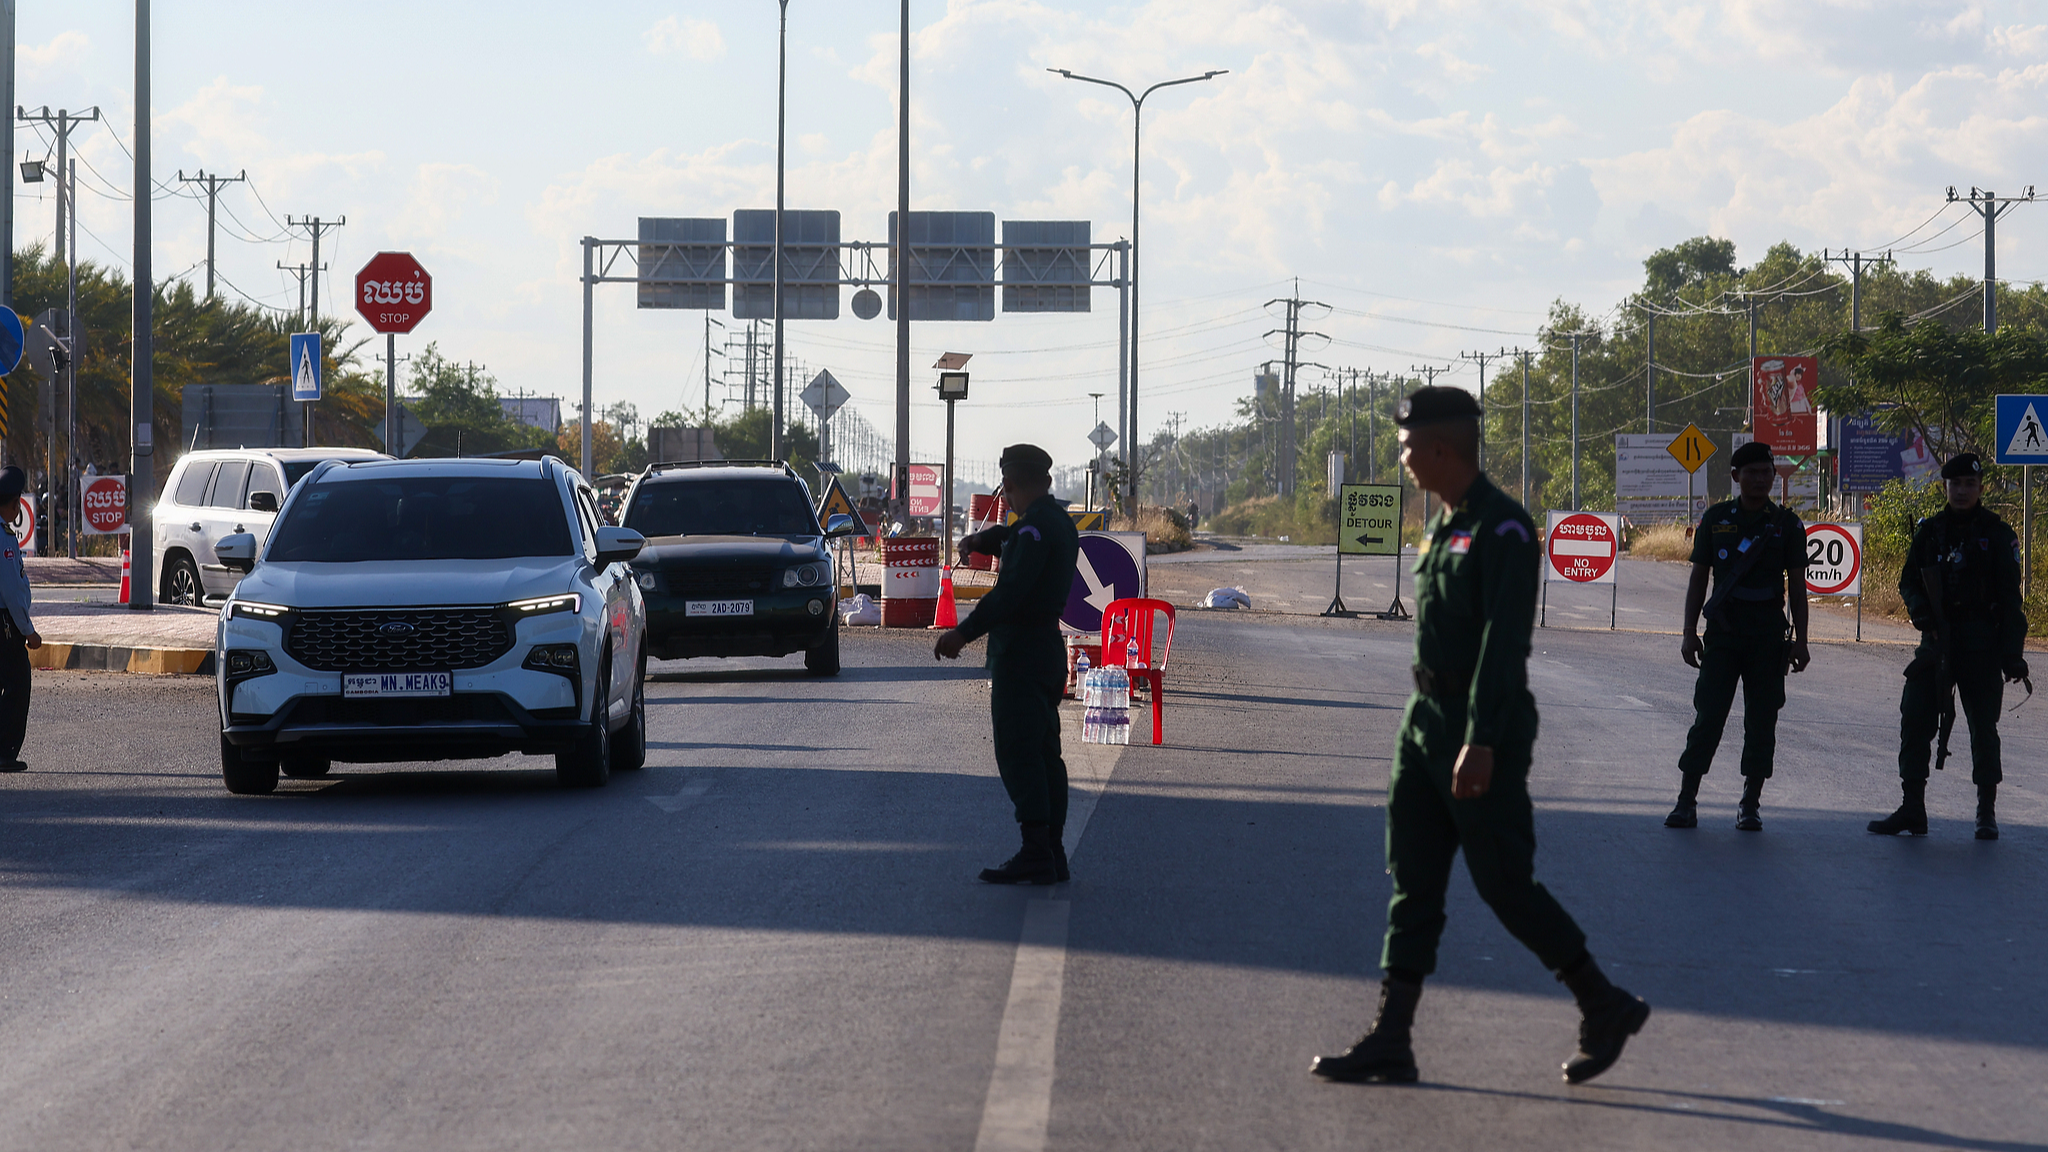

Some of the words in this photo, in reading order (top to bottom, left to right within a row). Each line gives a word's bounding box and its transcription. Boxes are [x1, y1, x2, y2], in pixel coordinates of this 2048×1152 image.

[363, 270, 425, 305] ឈប់
[379, 312, 410, 324] STOP
[92, 512, 123, 524] STOP
[1346, 517, 1393, 530] DETOUR
[1559, 523, 1607, 541] ហាមចូល
[1807, 538, 1844, 567] 20
[1573, 558, 1590, 568] NO
[1563, 567, 1599, 578] ENTRY
[1806, 567, 1842, 580] km/h
[711, 602, 750, 614] 2AD-2079
[380, 674, 447, 691] MN.MEAK9
